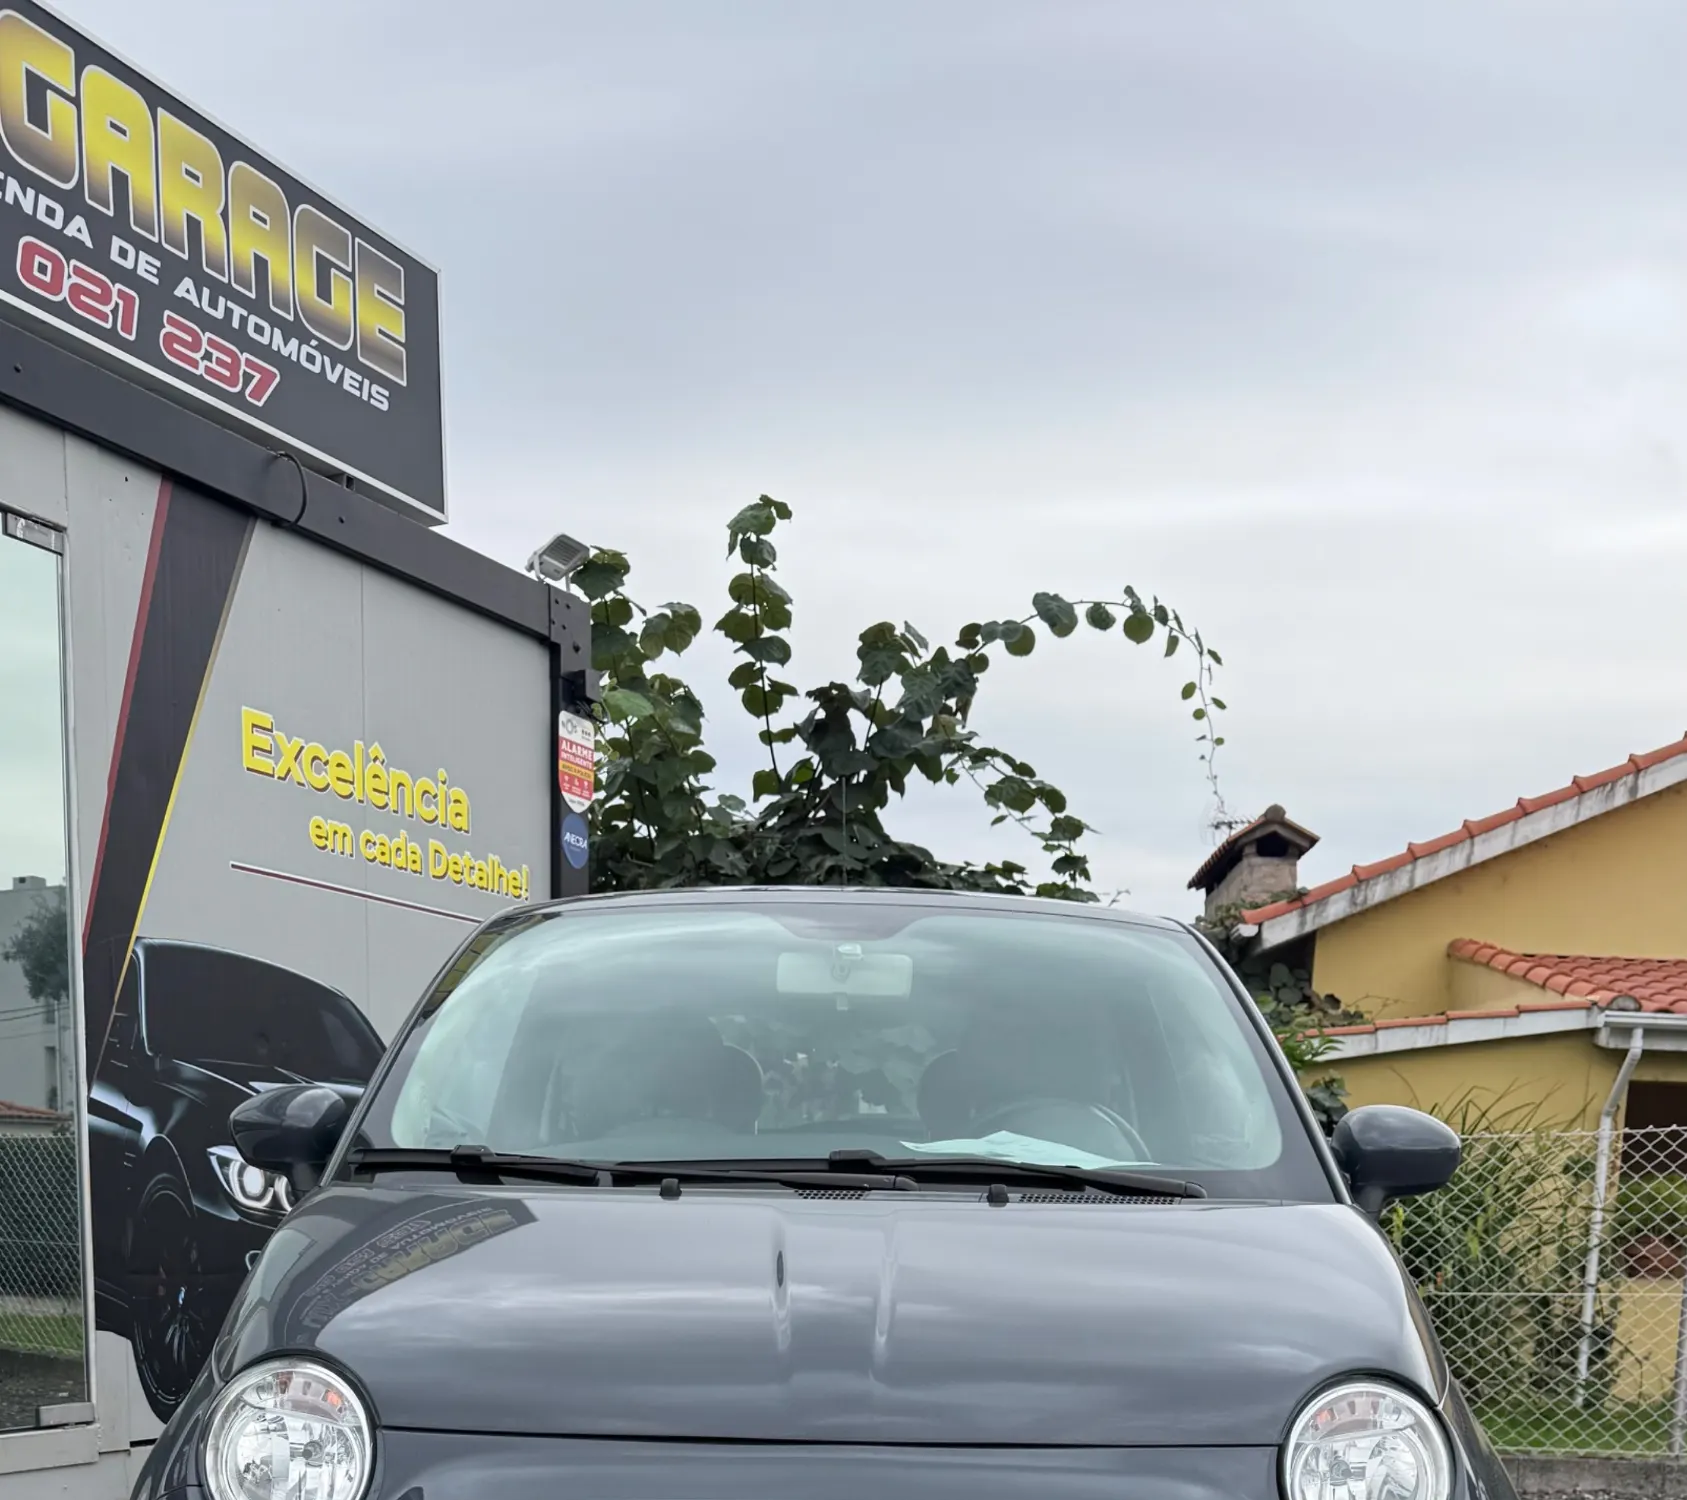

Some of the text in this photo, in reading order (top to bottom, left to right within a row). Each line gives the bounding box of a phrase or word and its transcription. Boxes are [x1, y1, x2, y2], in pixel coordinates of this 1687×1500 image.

[0, 8, 407, 387] GARAGE
[0, 170, 390, 412] NDA DE AUTOMÓVEIS
[15, 234, 281, 407] 021 237
[241, 705, 472, 835] Excelência
[561, 738, 594, 762] ALARME
[308, 815, 530, 902] em cada Detalhe!
